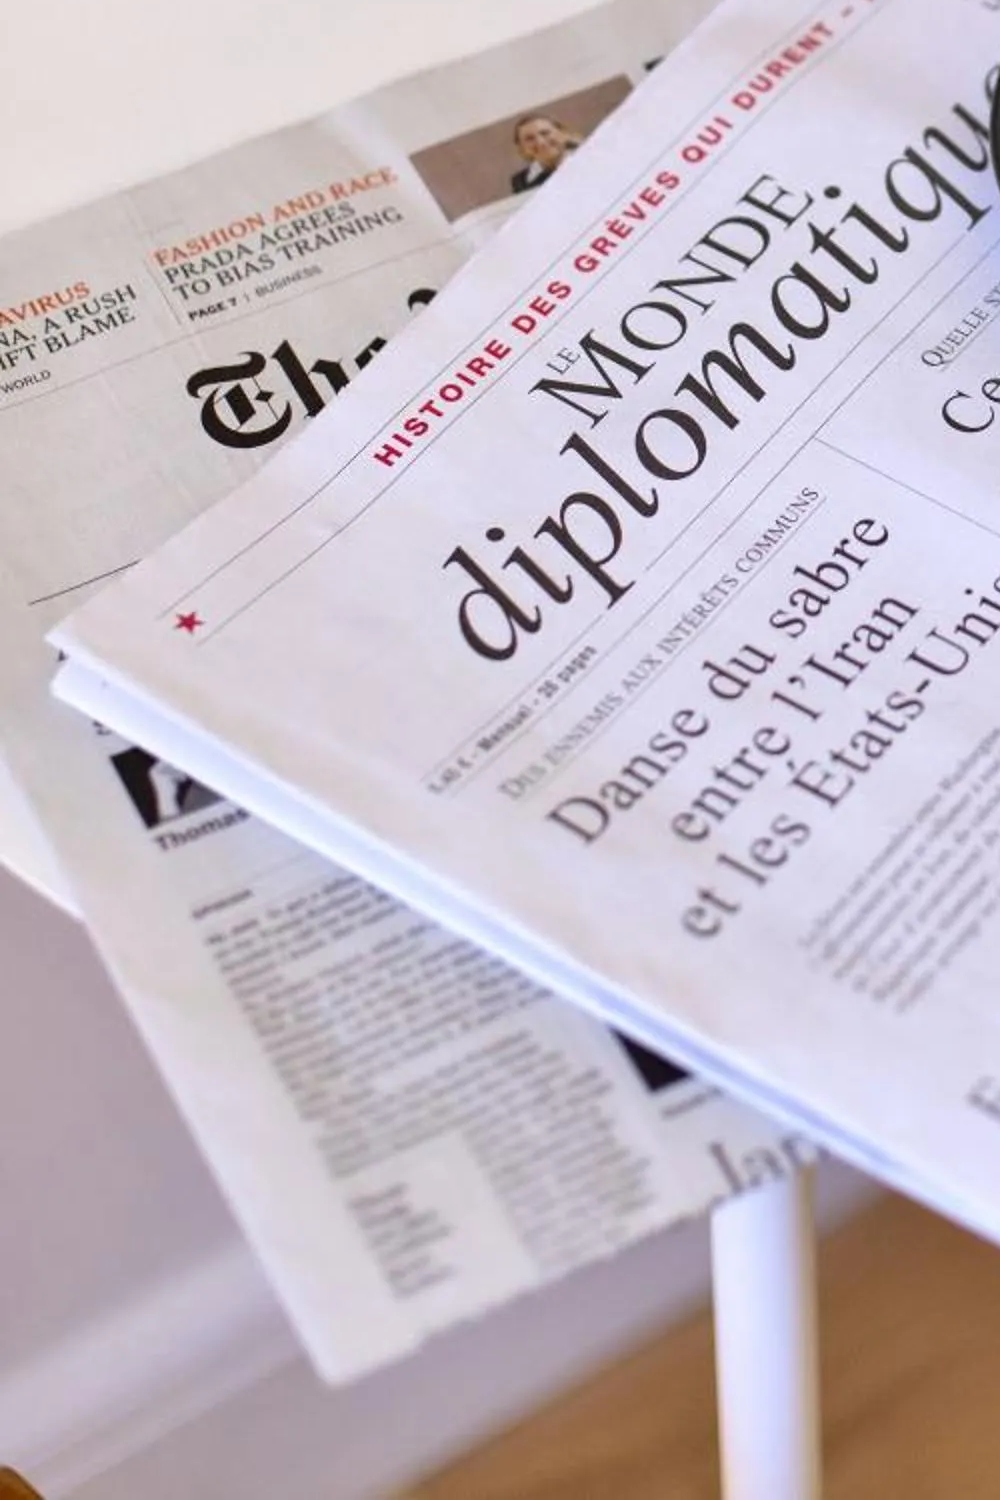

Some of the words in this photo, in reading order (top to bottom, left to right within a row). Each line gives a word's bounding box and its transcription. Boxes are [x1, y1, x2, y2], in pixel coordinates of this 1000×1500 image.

[152, 210, 267, 269] FASHION
[270, 191, 328, 224] AND
[329, 166, 399, 202] RACE
[163, 244, 255, 286] PRADA
[257, 201, 357, 251] AGREES
[172, 278, 212, 303] TO
[217, 256, 276, 290] BIAS
[276, 206, 404, 262] TRAINING
[372, 337, 513, 468] HISTOIRE
[510, 278, 573, 336] DES
[573, 169, 682, 274] GRÈVES
[681, 116, 735, 164] QUI
[731, 20, 835, 113] DURENT
[43, 312, 61, 334] A
[64, 283, 138, 324] RUSH
[45, 305, 136, 355] BLAME
[188, 302, 228, 323] PAGE
[254, 264, 324, 298] BUSINESS
[527, 173, 814, 430] MONDE
[921, 306, 991, 369] QUELLE
[0, 368, 52, 395] WORLD
[545, 344, 582, 377] LE
[542, 689, 626, 766] ENNEMIS
[615, 651, 664, 693] AUX
[651, 572, 743, 655] INTÉRÊTS
[728, 486, 824, 574] COMMUNS
[545, 707, 711, 847] Danse
[700, 641, 777, 704] du
[770, 515, 891, 640] sabre
[670, 723, 793, 847] entre
[771, 596, 921, 723] l’Iran
[680, 886, 742, 940] et
[718, 813, 812, 889] les
